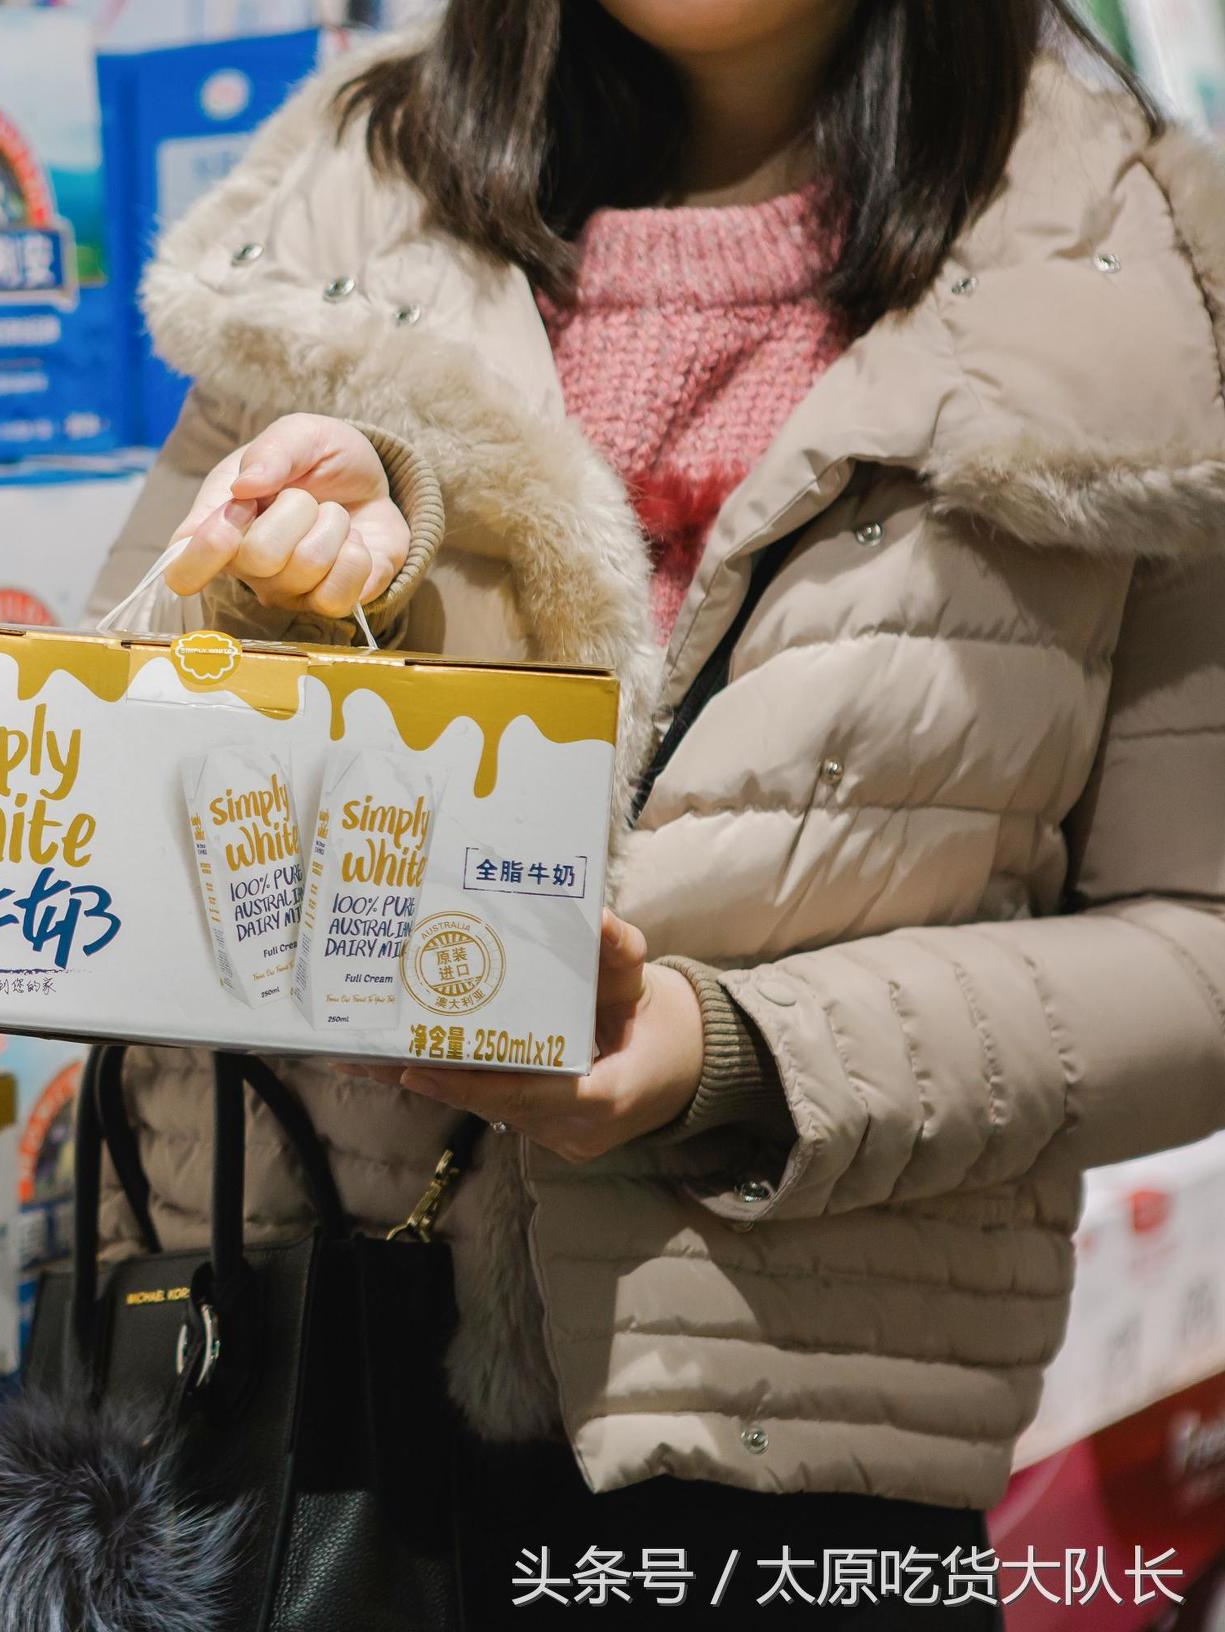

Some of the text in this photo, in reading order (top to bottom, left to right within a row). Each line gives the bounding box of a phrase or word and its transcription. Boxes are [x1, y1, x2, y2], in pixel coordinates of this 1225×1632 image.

[209, 773, 290, 827] simply
[342, 795, 430, 851] simply
[476, 859, 575, 887] 全脂牛奶
[230, 873, 271, 902] 100%
[332, 893, 379, 916] 100%
[236, 911, 280, 942] DAIRY
[421, 921, 471, 940] AUSTRALIA
[279, 941, 298, 953] Crea
[324, 938, 378, 958] DAIRY
[437, 947, 467, 965] 原装
[344, 974, 394, 984] Full Cream
[439, 963, 469, 981] 进口
[435, 988, 485, 1010] 澳大利亚
